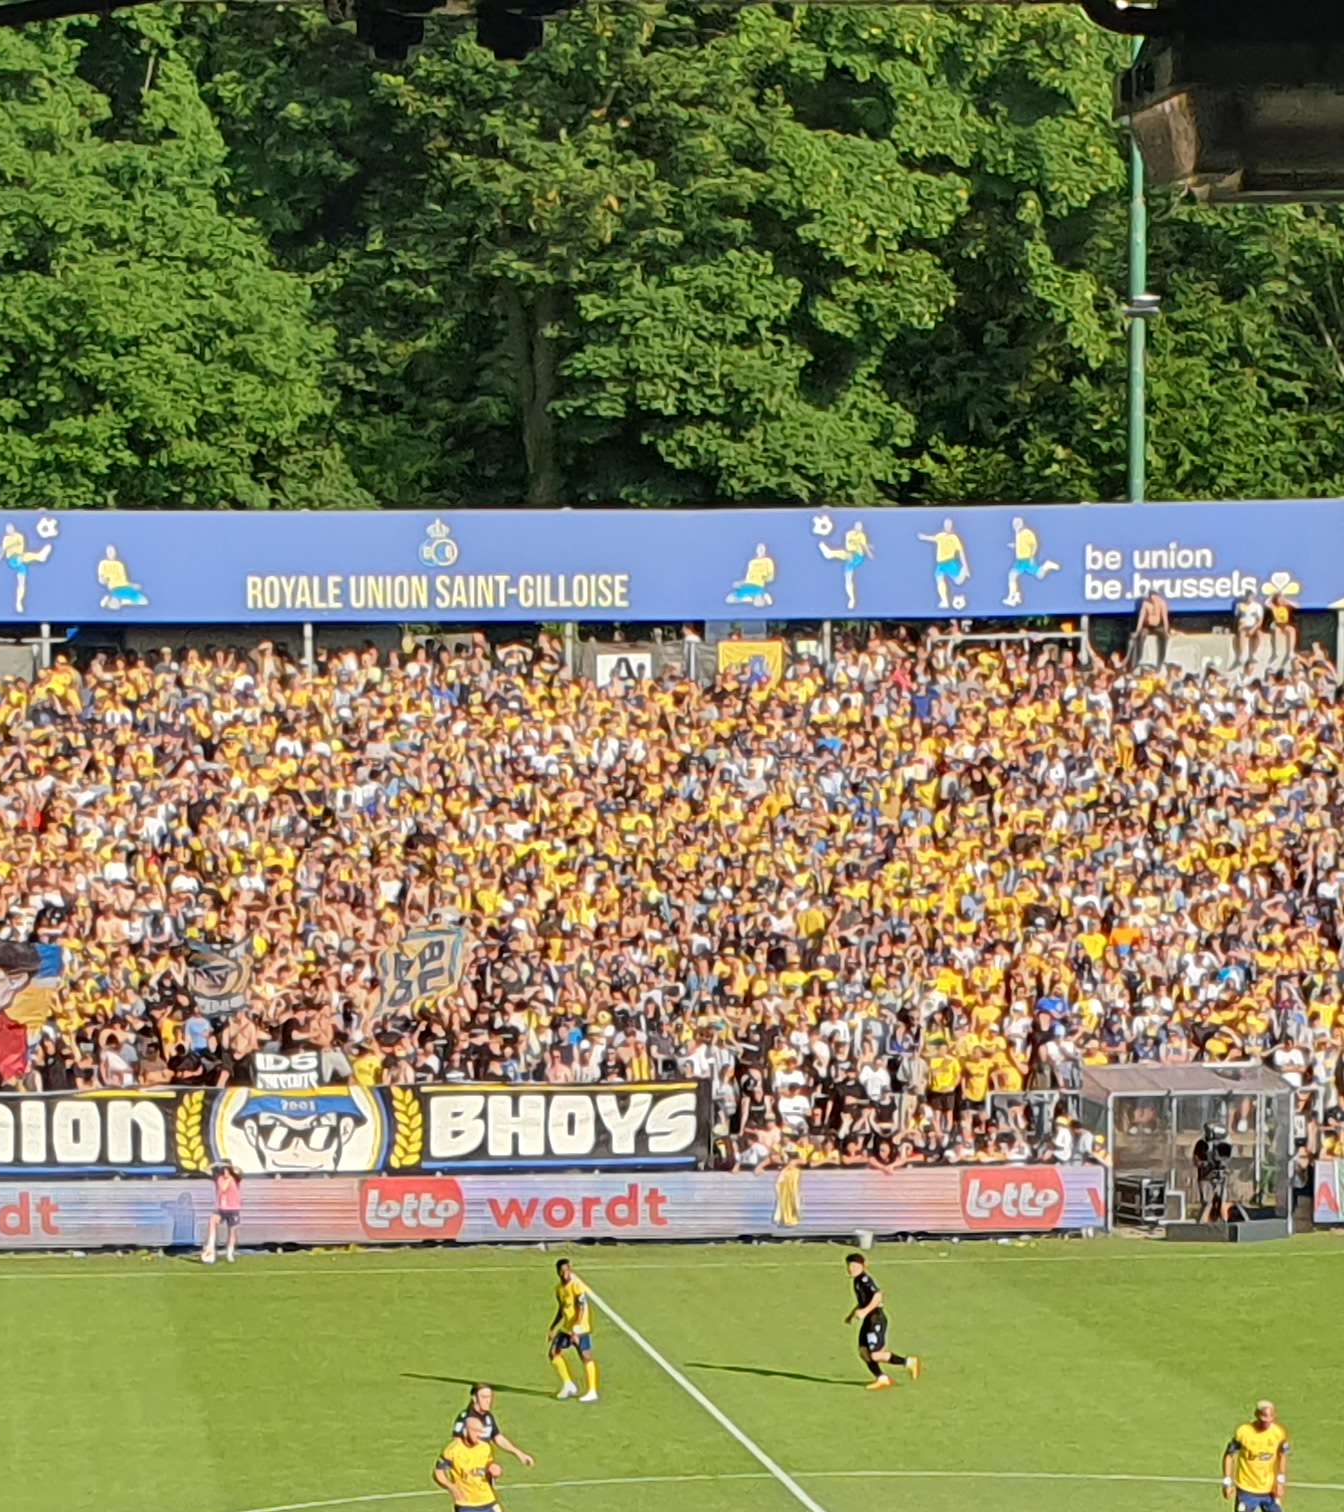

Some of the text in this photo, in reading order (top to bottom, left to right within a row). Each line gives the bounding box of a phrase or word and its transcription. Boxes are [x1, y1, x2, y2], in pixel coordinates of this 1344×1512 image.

[1085, 541, 1212, 570] be union
[246, 573, 630, 609] ROYALE UNION SAINT-GILLOISE
[428, 1092, 698, 1159] BHOYS
[489, 1182, 669, 1229] wordt
